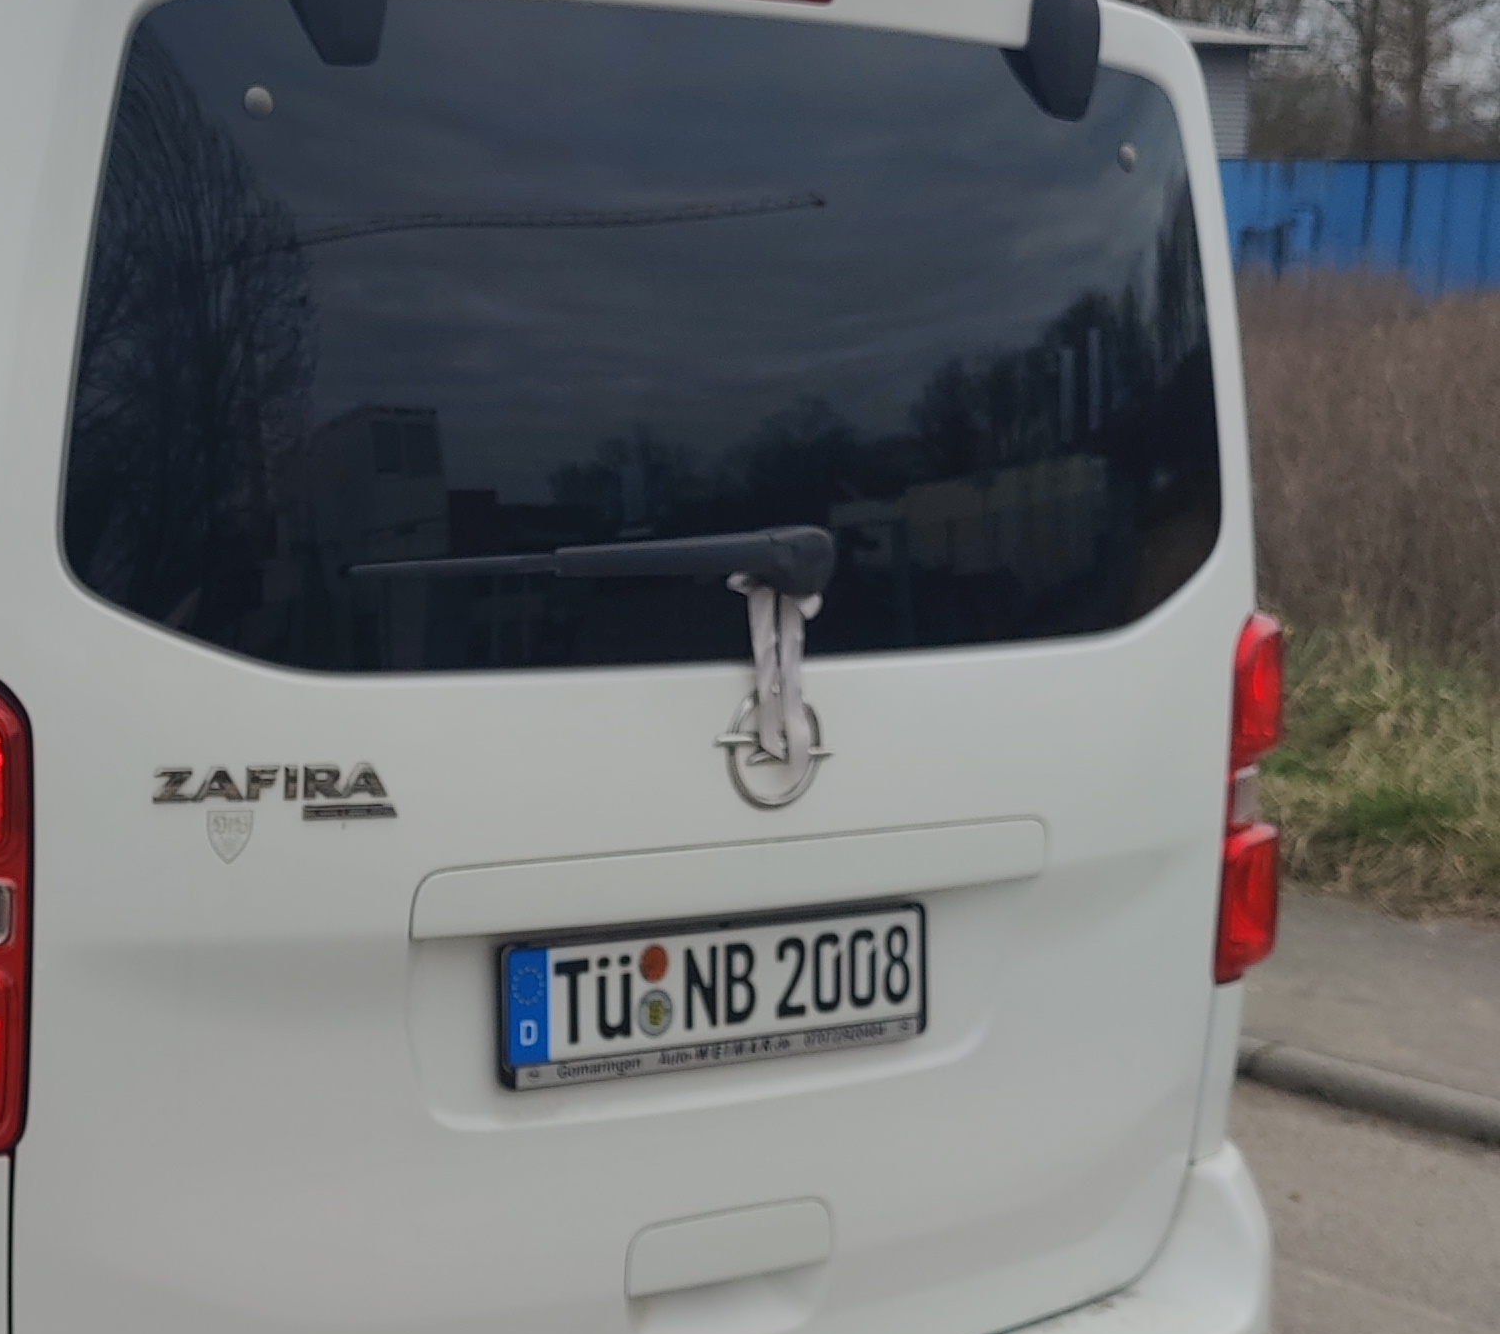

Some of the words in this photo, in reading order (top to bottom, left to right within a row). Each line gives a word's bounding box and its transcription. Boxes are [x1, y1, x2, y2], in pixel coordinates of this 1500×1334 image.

[152, 763, 388, 803] ZAFIRA
[684, 942, 756, 1031] NB
[775, 925, 911, 1019] 2008
[519, 1020, 538, 1046] D
